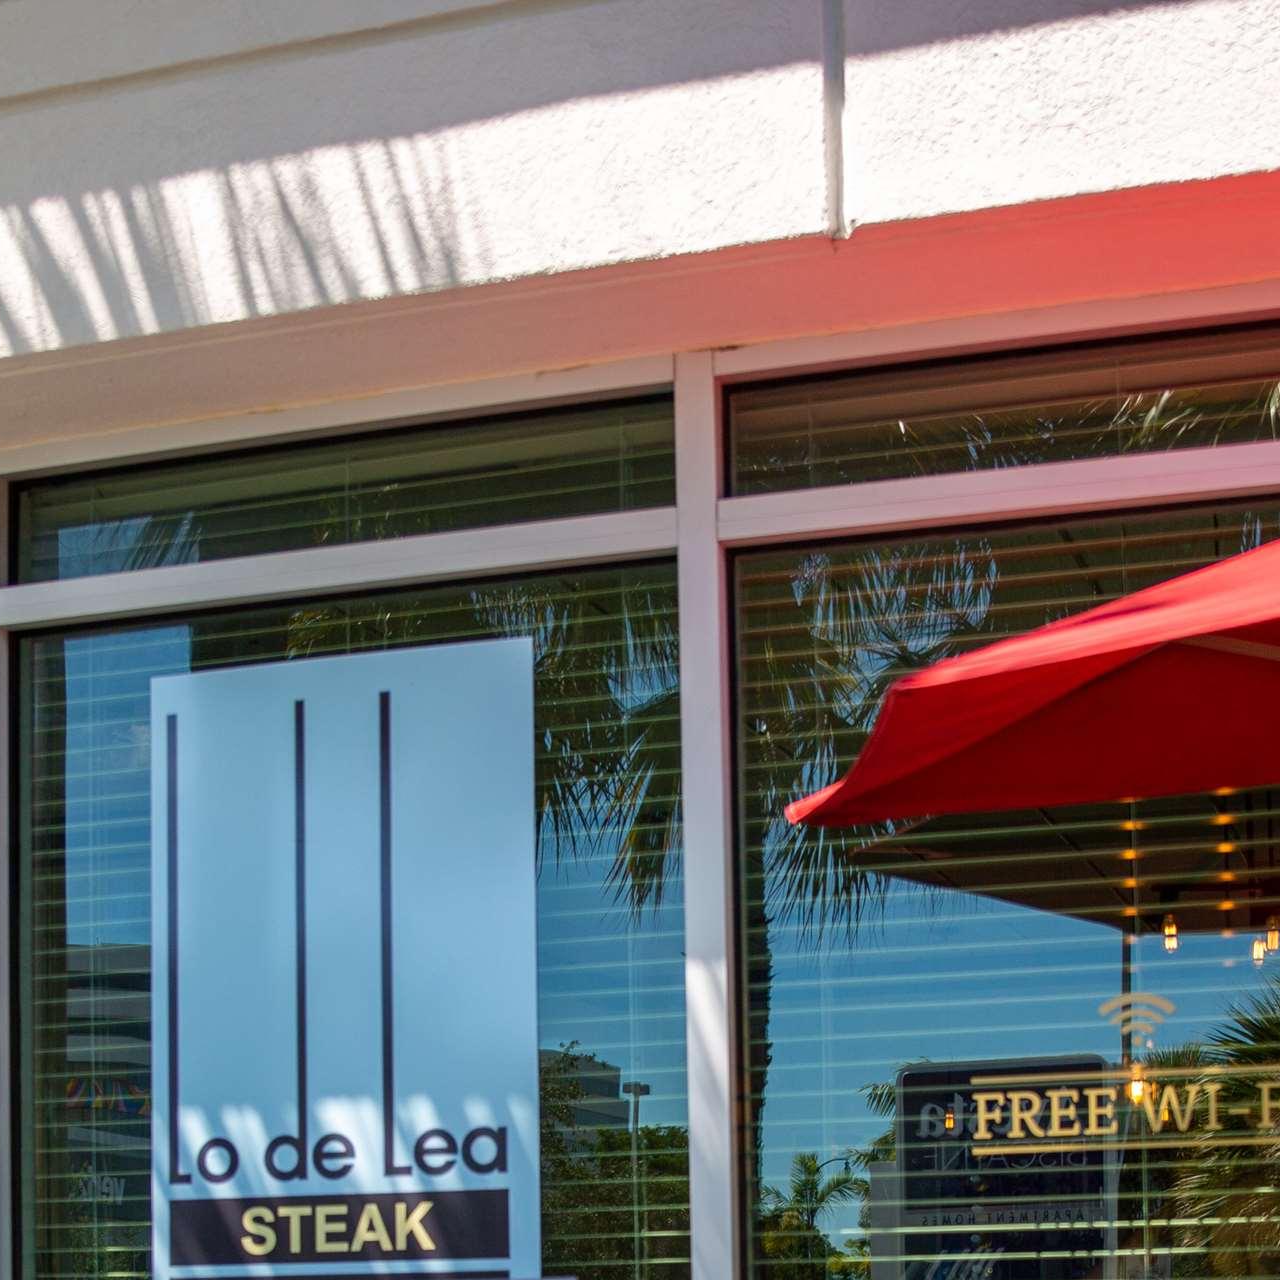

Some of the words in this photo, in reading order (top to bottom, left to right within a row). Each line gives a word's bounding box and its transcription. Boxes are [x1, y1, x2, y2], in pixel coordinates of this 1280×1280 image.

[168, 713, 239, 1184] Lo
[264, 699, 356, 1181] de
[379, 690, 508, 1176] Lea
[972, 1086, 1119, 1140] FREE
[240, 1201, 436, 1256] STEAK
